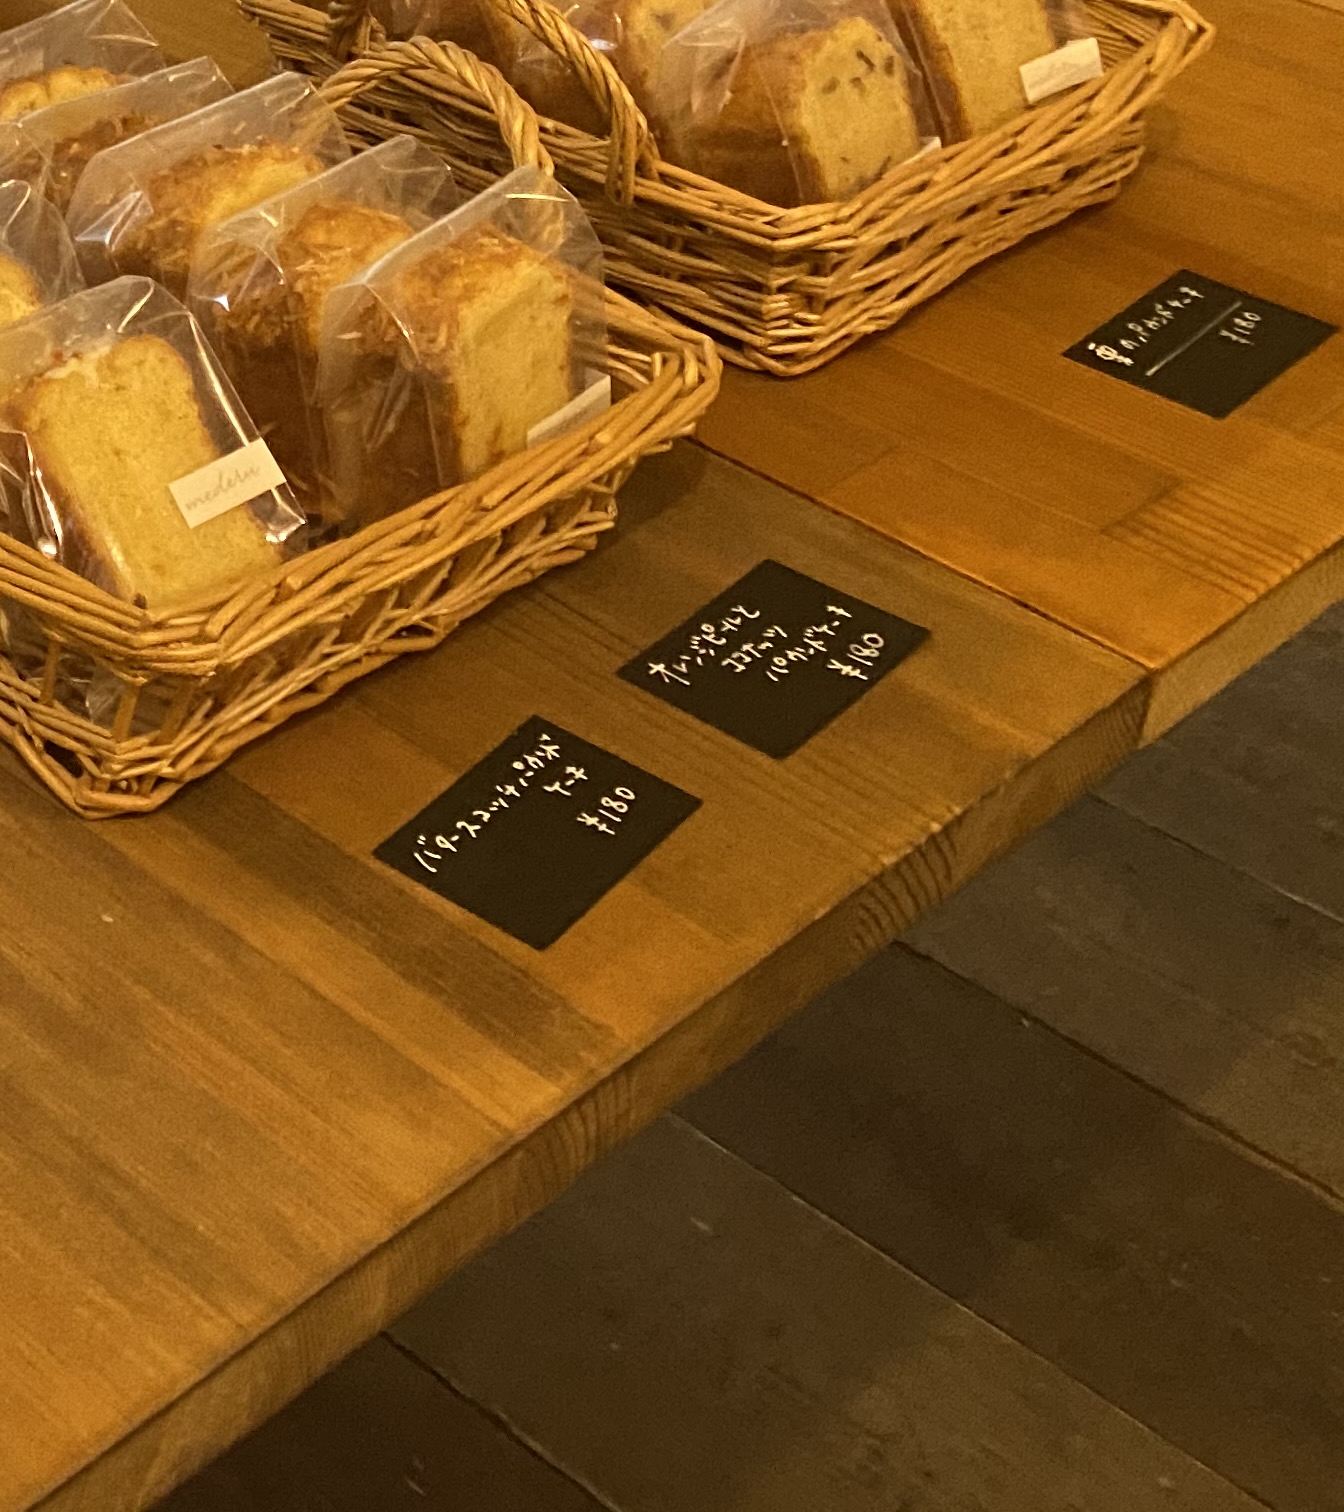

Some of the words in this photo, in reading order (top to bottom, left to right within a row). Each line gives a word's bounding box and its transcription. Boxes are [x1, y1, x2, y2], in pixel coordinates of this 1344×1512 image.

[1219, 311, 1262, 345] ¥180
[721, 625, 788, 672] ココナッツ
[766, 604, 852, 682] パウンドケーキ
[826, 631, 886, 682] ¥180
[542, 765, 589, 797] ケーキ
[576, 785, 638, 836] ¥180
